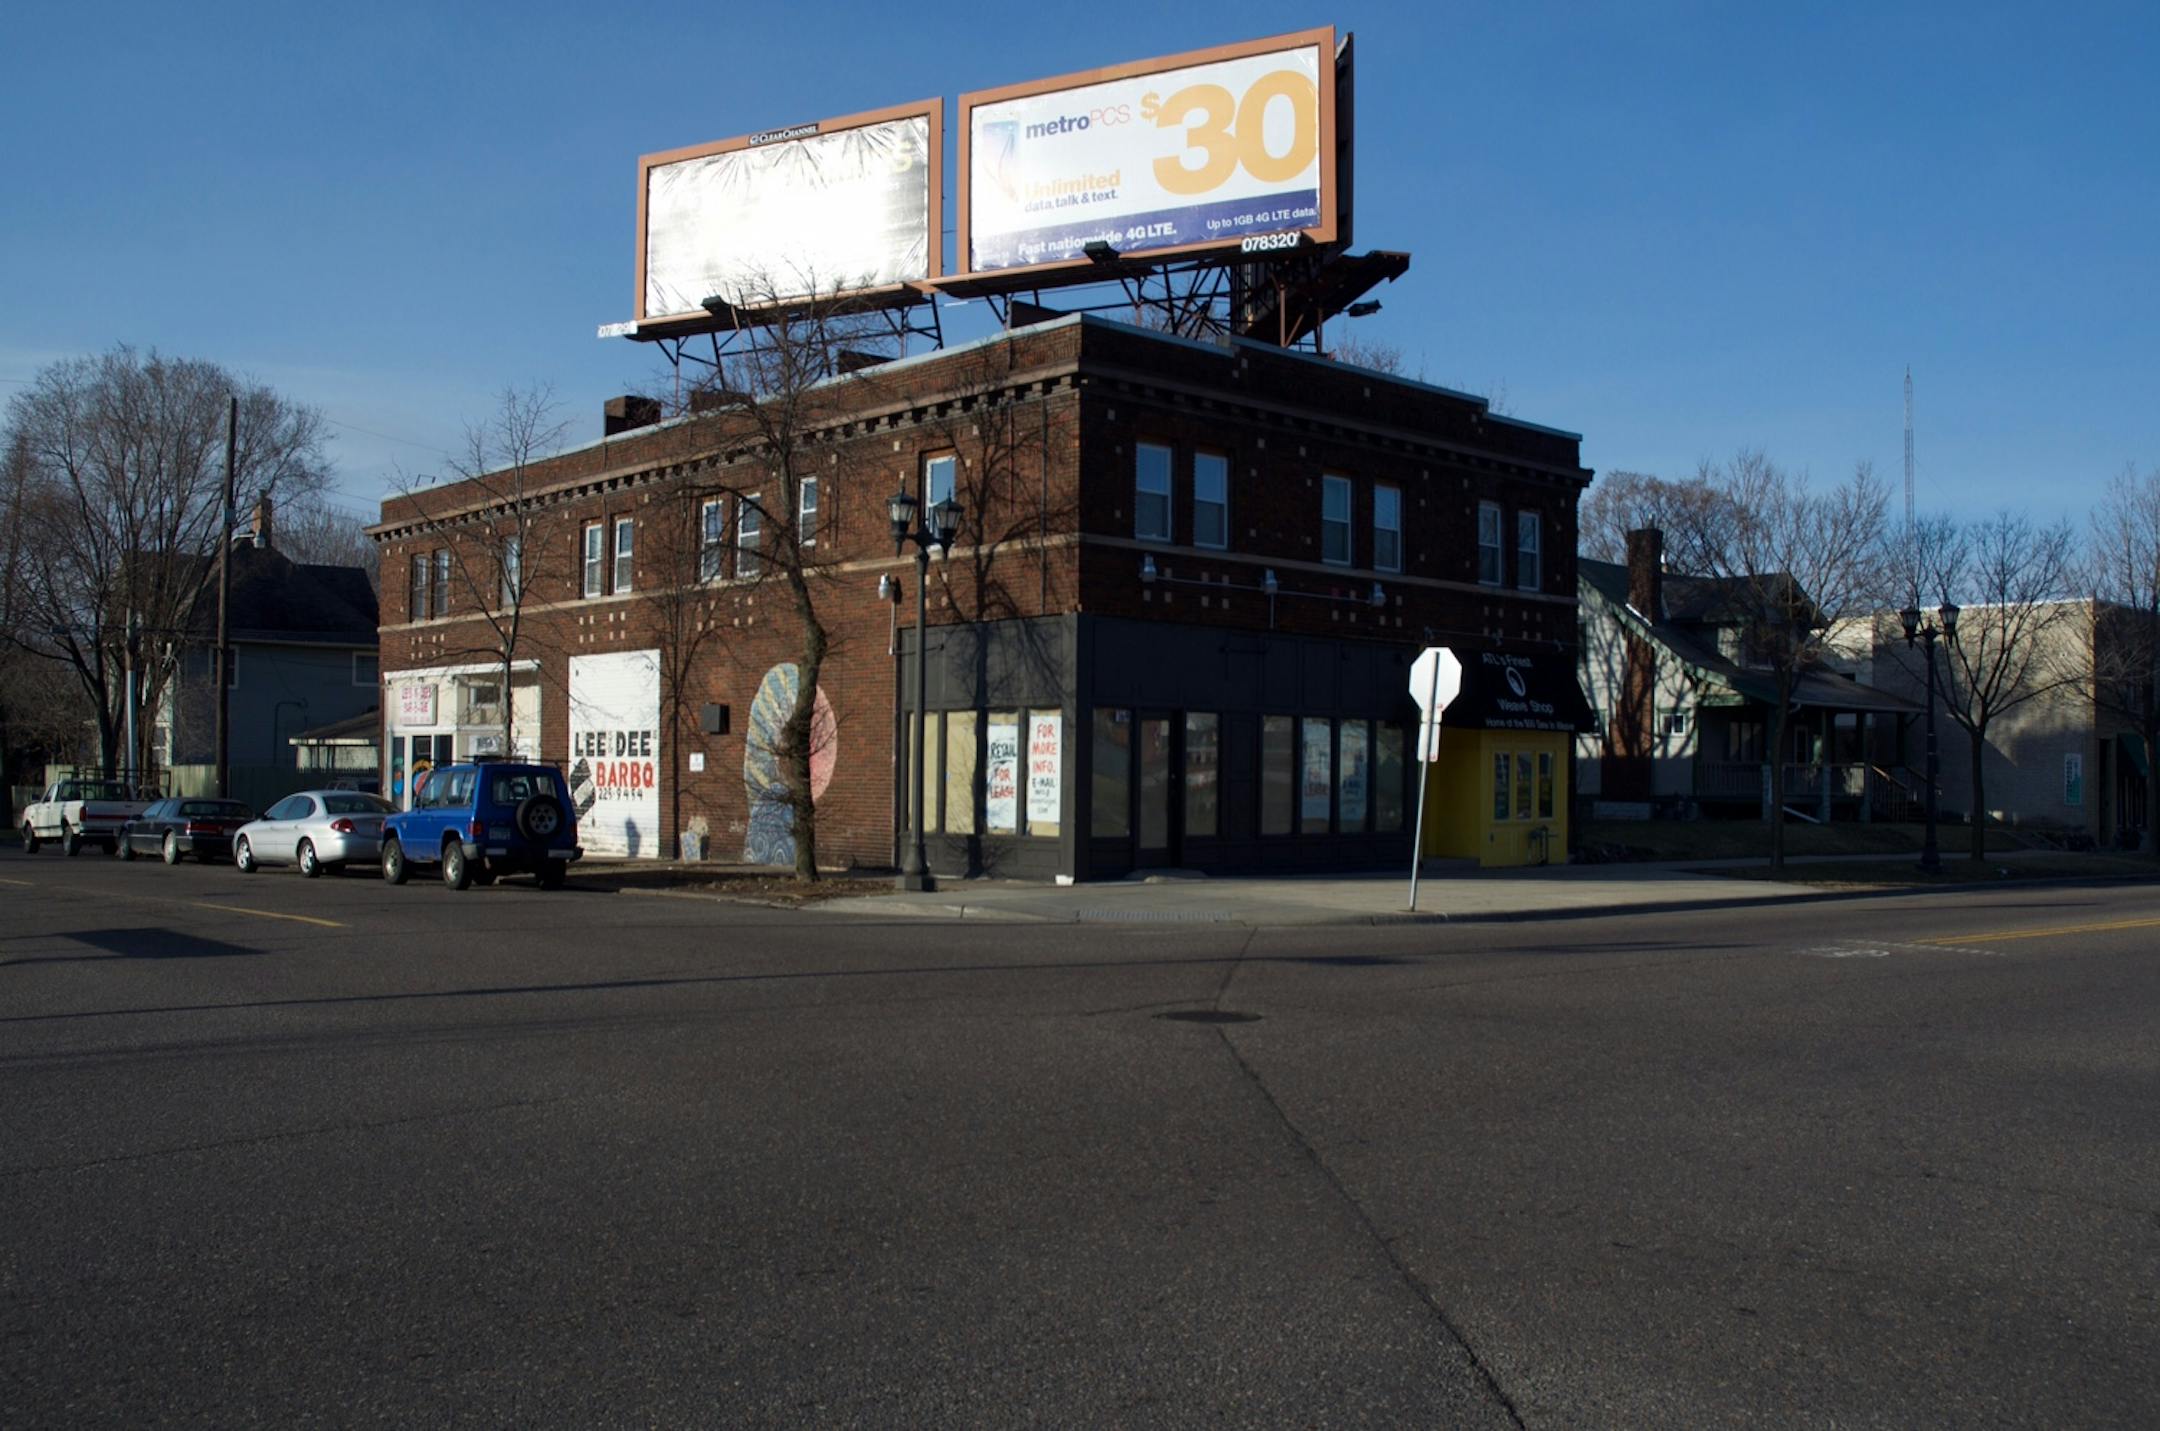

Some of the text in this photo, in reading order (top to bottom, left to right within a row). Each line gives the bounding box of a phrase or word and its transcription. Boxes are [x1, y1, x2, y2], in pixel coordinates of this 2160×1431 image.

[1025, 104, 1131, 139] metroPCS
[1140, 70, 1318, 195] $30
[1025, 169, 1121, 199] Unlimited
[1055, 193, 1079, 209] talk
[1081, 192, 1091, 204] &
[1092, 189, 1118, 203] text.
[1207, 207, 1317, 231] Up to 1GB 4G LTE data.
[1019, 240, 1046, 256] Fast
[1126, 226, 1146, 241] 4G
[1147, 222, 1177, 238] LTE.
[1242, 232, 1298, 252] 078320
[1529, 699, 1554, 716] Shop
[1037, 723, 1055, 738] FOR
[575, 732, 606, 756] LEE
[616, 731, 651, 756] DEE
[991, 742, 1017, 759] RETAIL
[1032, 741, 1056, 755] MORE
[596, 761, 654, 788] BARBQ
[994, 767, 1011, 782] FOR
[1033, 760, 1056, 773] INFO.
[991, 785, 1015, 799] LEASE
